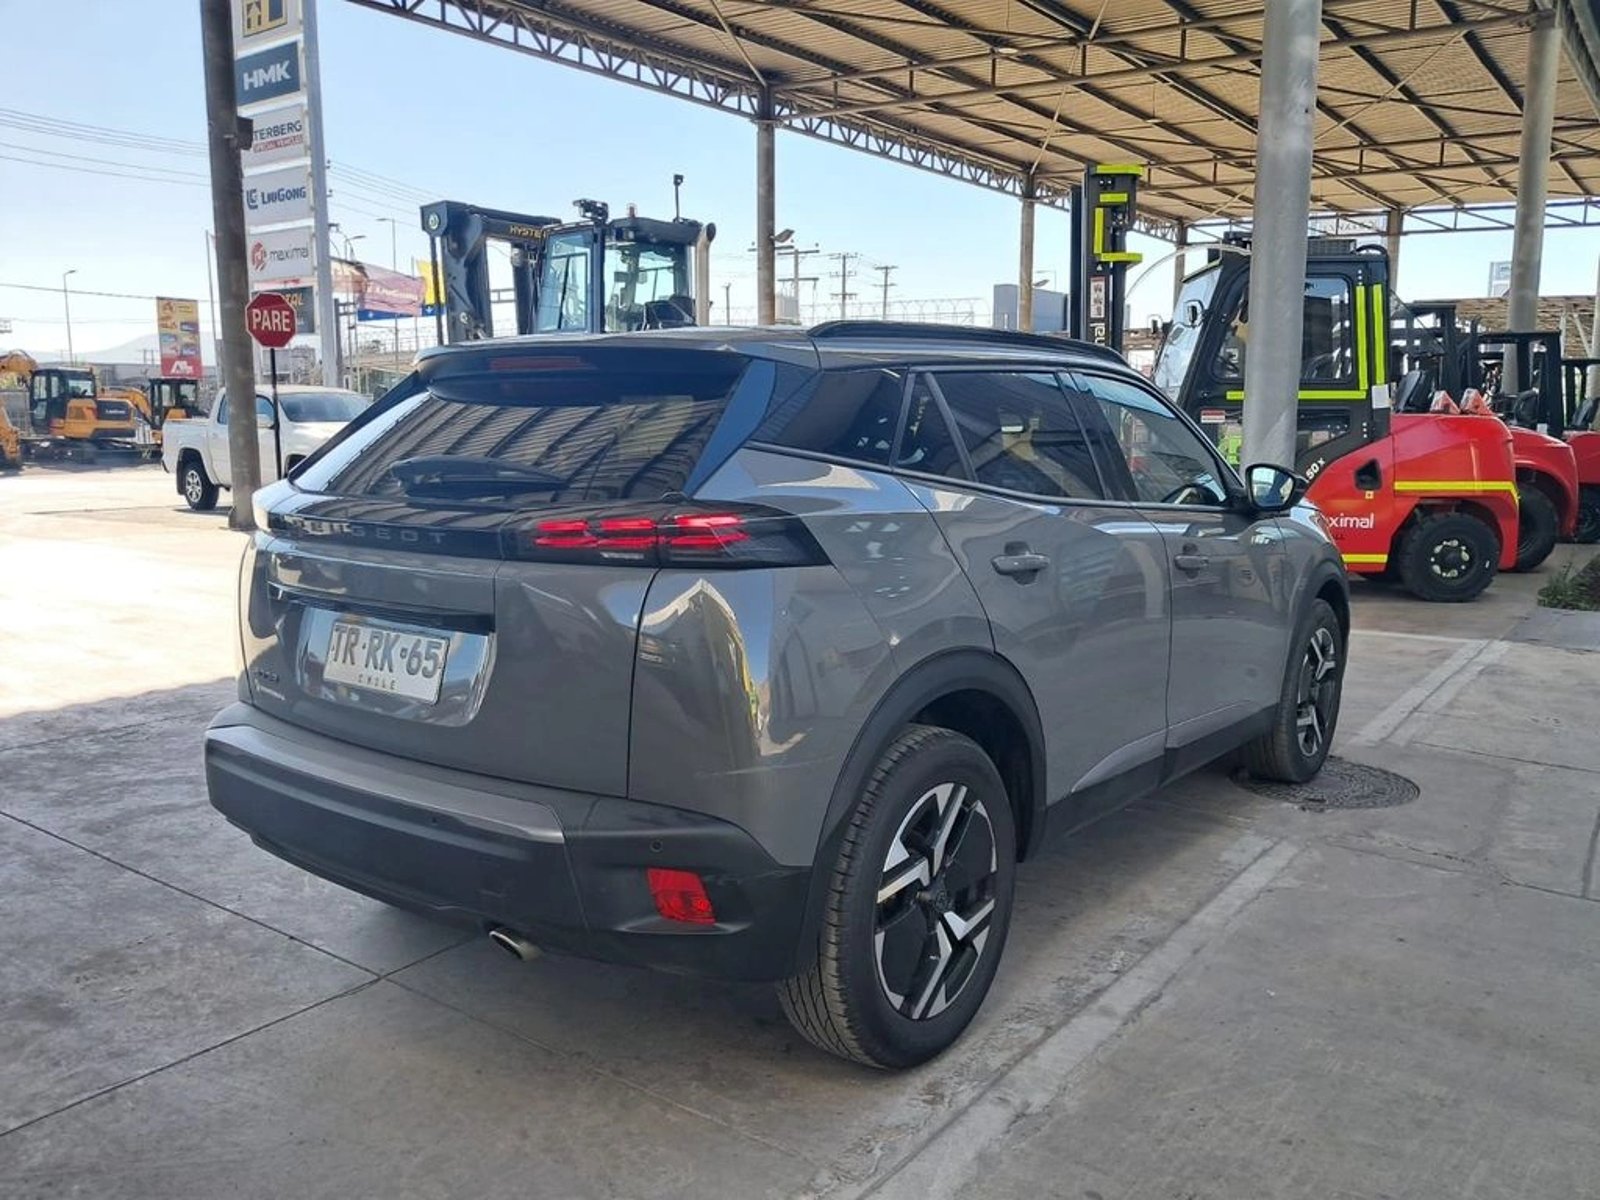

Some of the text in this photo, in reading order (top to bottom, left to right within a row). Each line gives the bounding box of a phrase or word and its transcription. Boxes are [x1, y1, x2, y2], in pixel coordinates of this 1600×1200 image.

[243, 60, 291, 91] HMK
[253, 120, 303, 141] TERBERG
[251, 308, 291, 332] PARE
[1329, 512, 1375, 529] ximal
[358, 673, 397, 691] CHILE
